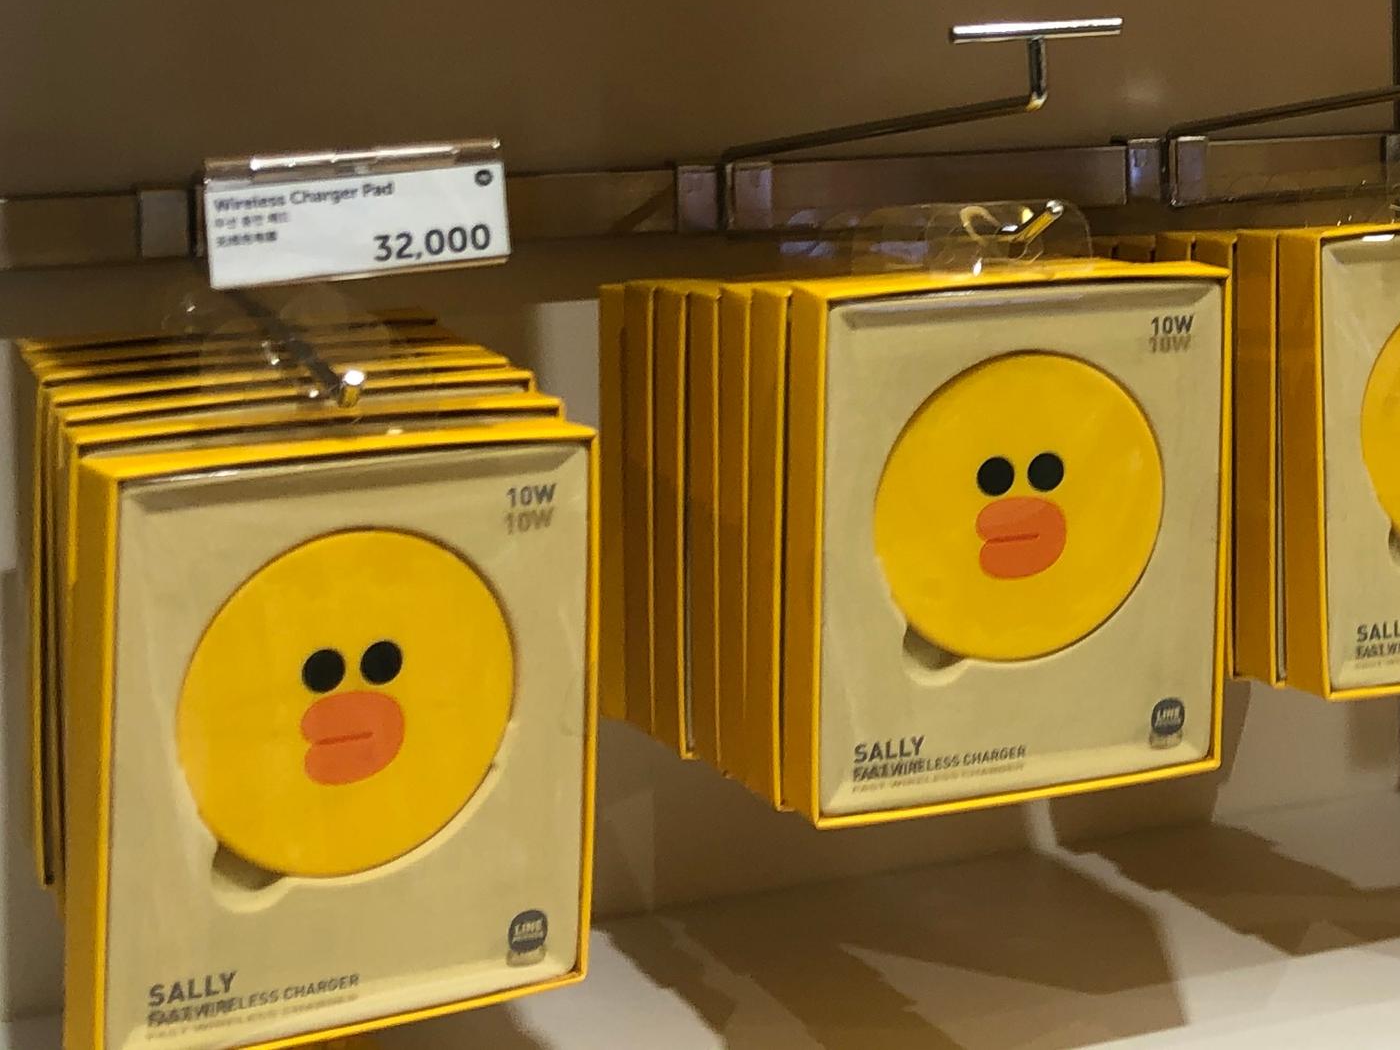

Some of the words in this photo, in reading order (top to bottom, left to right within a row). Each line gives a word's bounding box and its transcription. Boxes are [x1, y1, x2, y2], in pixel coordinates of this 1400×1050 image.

[214, 195, 285, 212] Wireless
[290, 185, 358, 205] Charger
[362, 181, 394, 198] Pad
[374, 223, 491, 262] 32,000
[1151, 314, 1194, 335] 10W
[506, 482, 557, 508] 10W
[853, 763, 889, 783] FAST
[891, 754, 960, 777] WIRELESS
[963, 745, 1026, 767] CHARGER
[854, 736, 925, 763] SALLY
[514, 920, 543, 935] LINE
[148, 970, 238, 1007] SALLY
[200, 990, 280, 1019] WIRELESS
[283, 973, 360, 1001] CHARGER
